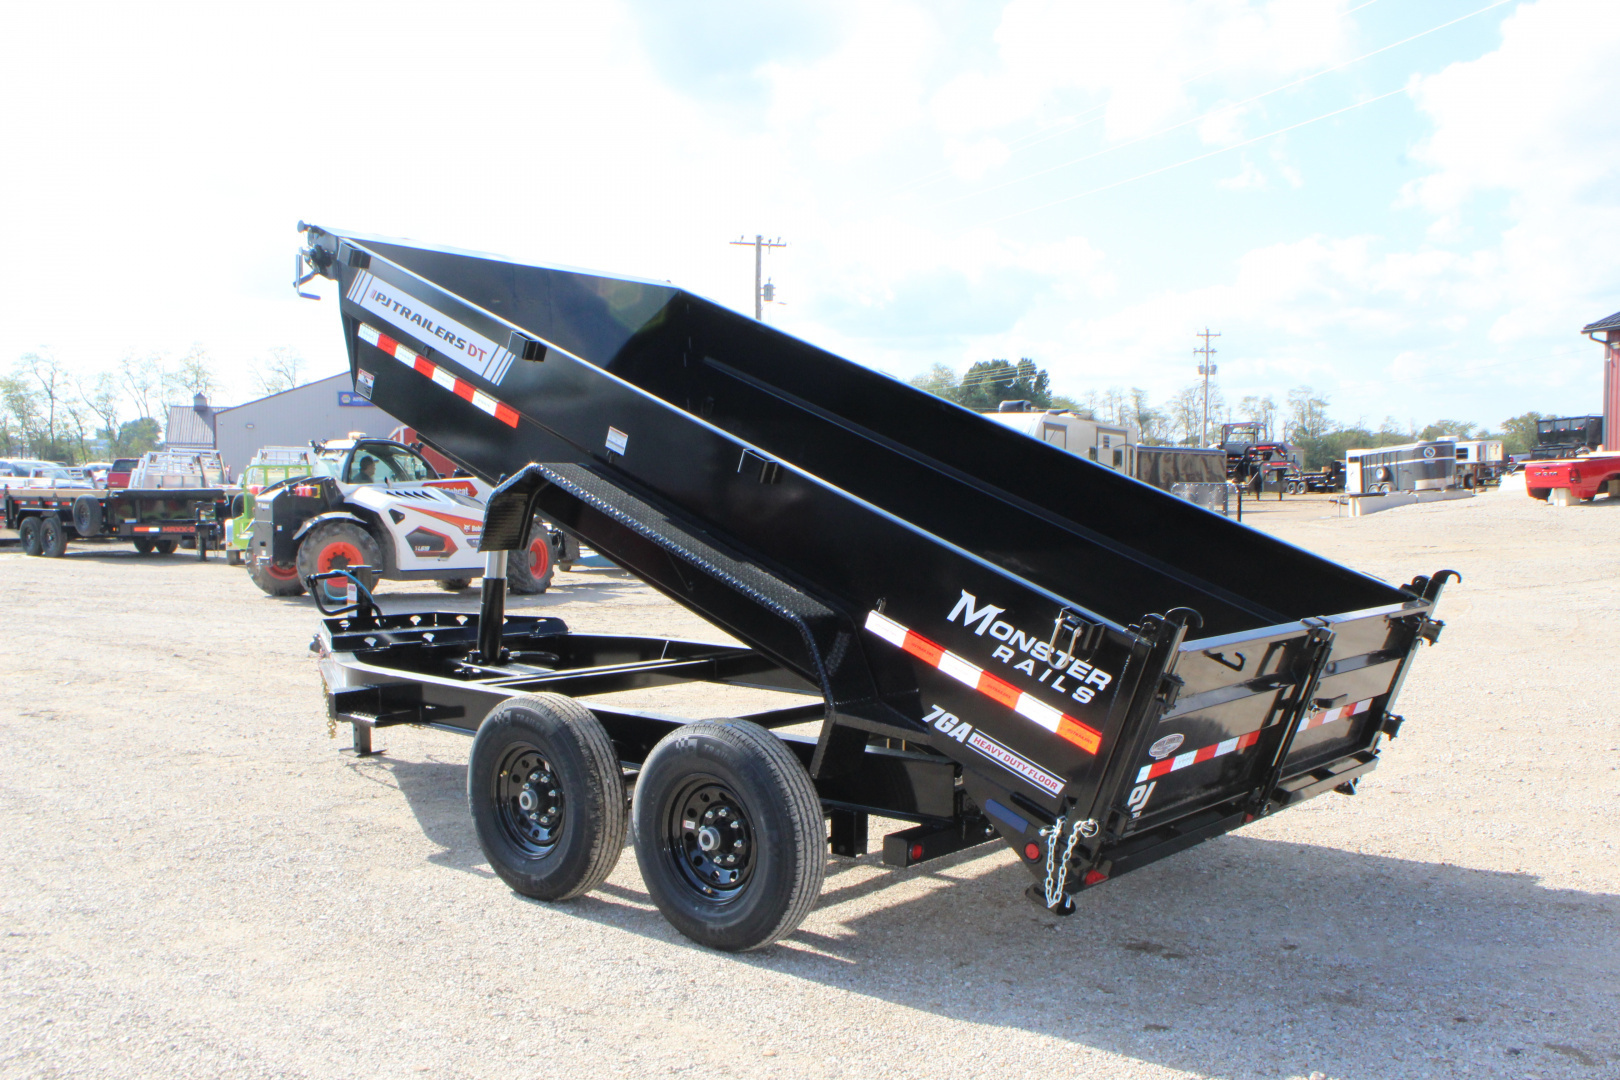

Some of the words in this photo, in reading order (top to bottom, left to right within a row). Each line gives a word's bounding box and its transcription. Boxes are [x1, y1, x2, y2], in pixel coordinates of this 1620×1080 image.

[467, 343, 487, 362] DT
[946, 588, 1113, 691] MONSTER
[992, 644, 1096, 704] RAILS
[921, 703, 973, 744] 7GA
[973, 736, 1004, 759] HEAVY
[1003, 753, 1029, 772] DUTY
[1027, 771, 1058, 791] FLOOR
